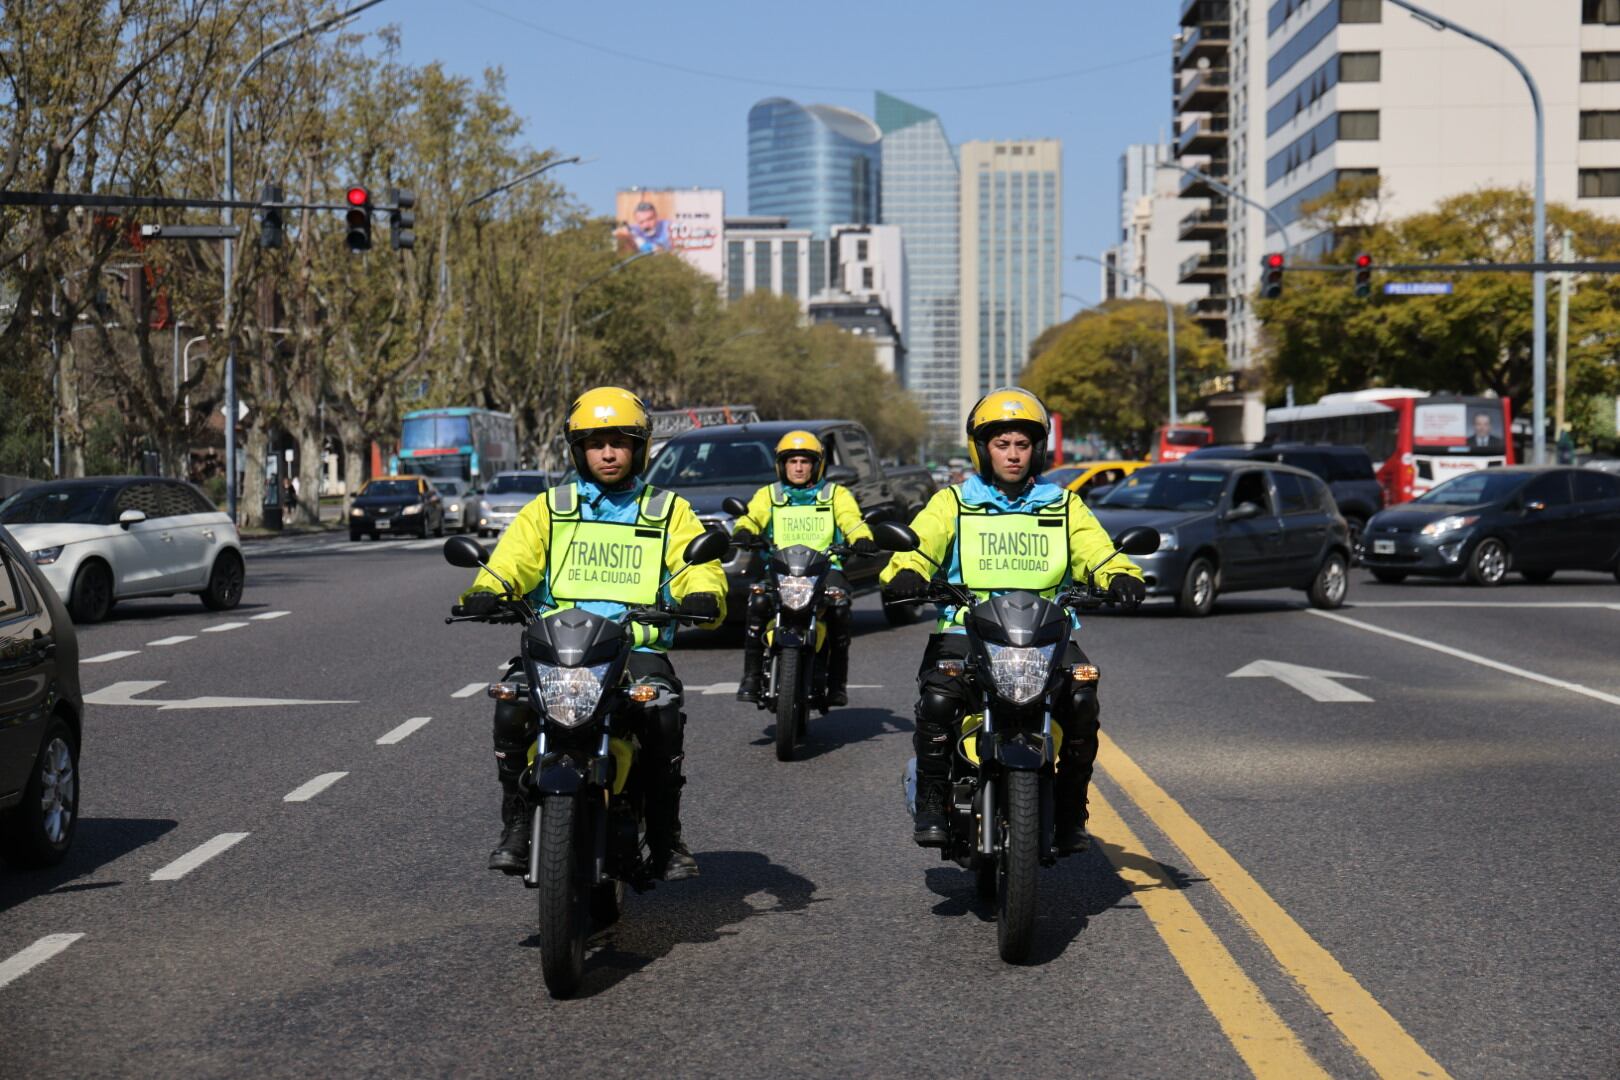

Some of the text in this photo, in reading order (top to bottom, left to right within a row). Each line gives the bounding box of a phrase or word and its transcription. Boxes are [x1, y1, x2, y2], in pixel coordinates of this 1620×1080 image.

[782, 516, 825, 532] TRANSITO
[978, 532, 1049, 557] TRANSITO
[571, 541, 642, 569] TRANSITO
[979, 558, 1049, 572] DE LA CIUDAD
[568, 568, 641, 584] DE LA CIUDAD
